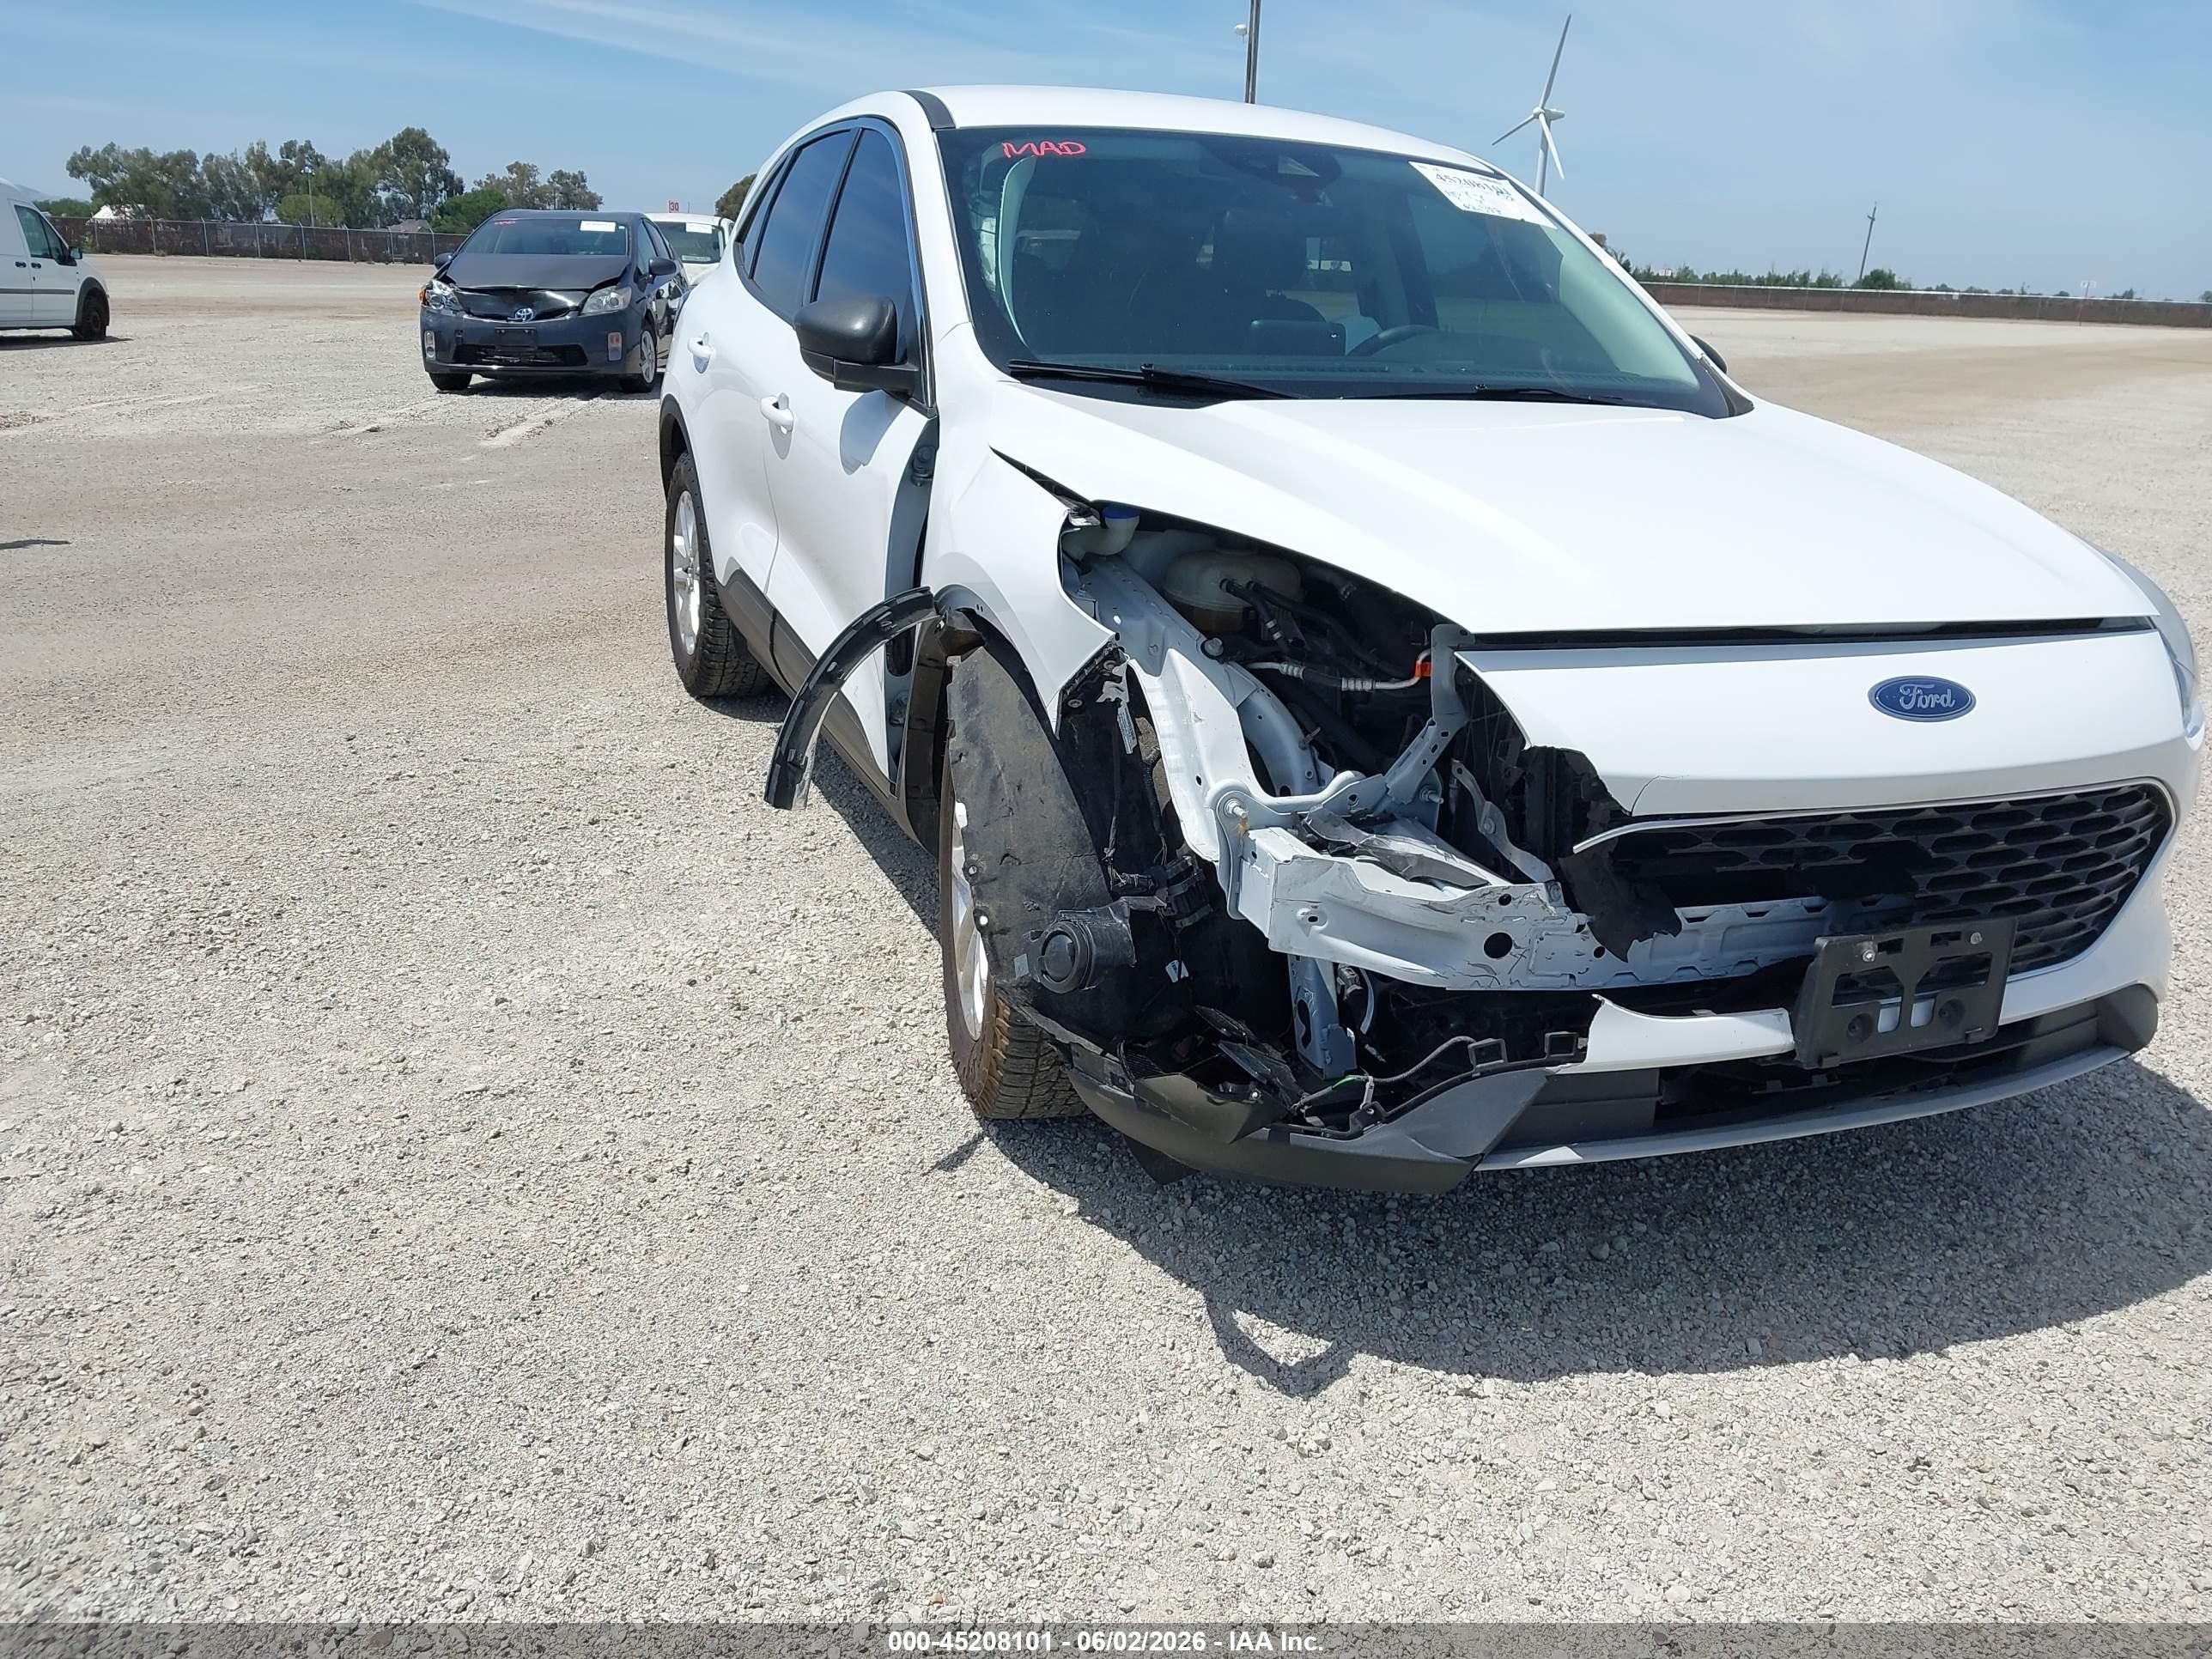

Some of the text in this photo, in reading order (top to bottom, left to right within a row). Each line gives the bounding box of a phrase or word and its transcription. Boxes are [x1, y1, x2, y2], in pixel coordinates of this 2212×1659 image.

[1001, 141, 1086, 158] MAD
[670, 202, 679, 211] 30
[1899, 684, 1955, 709] Ford
